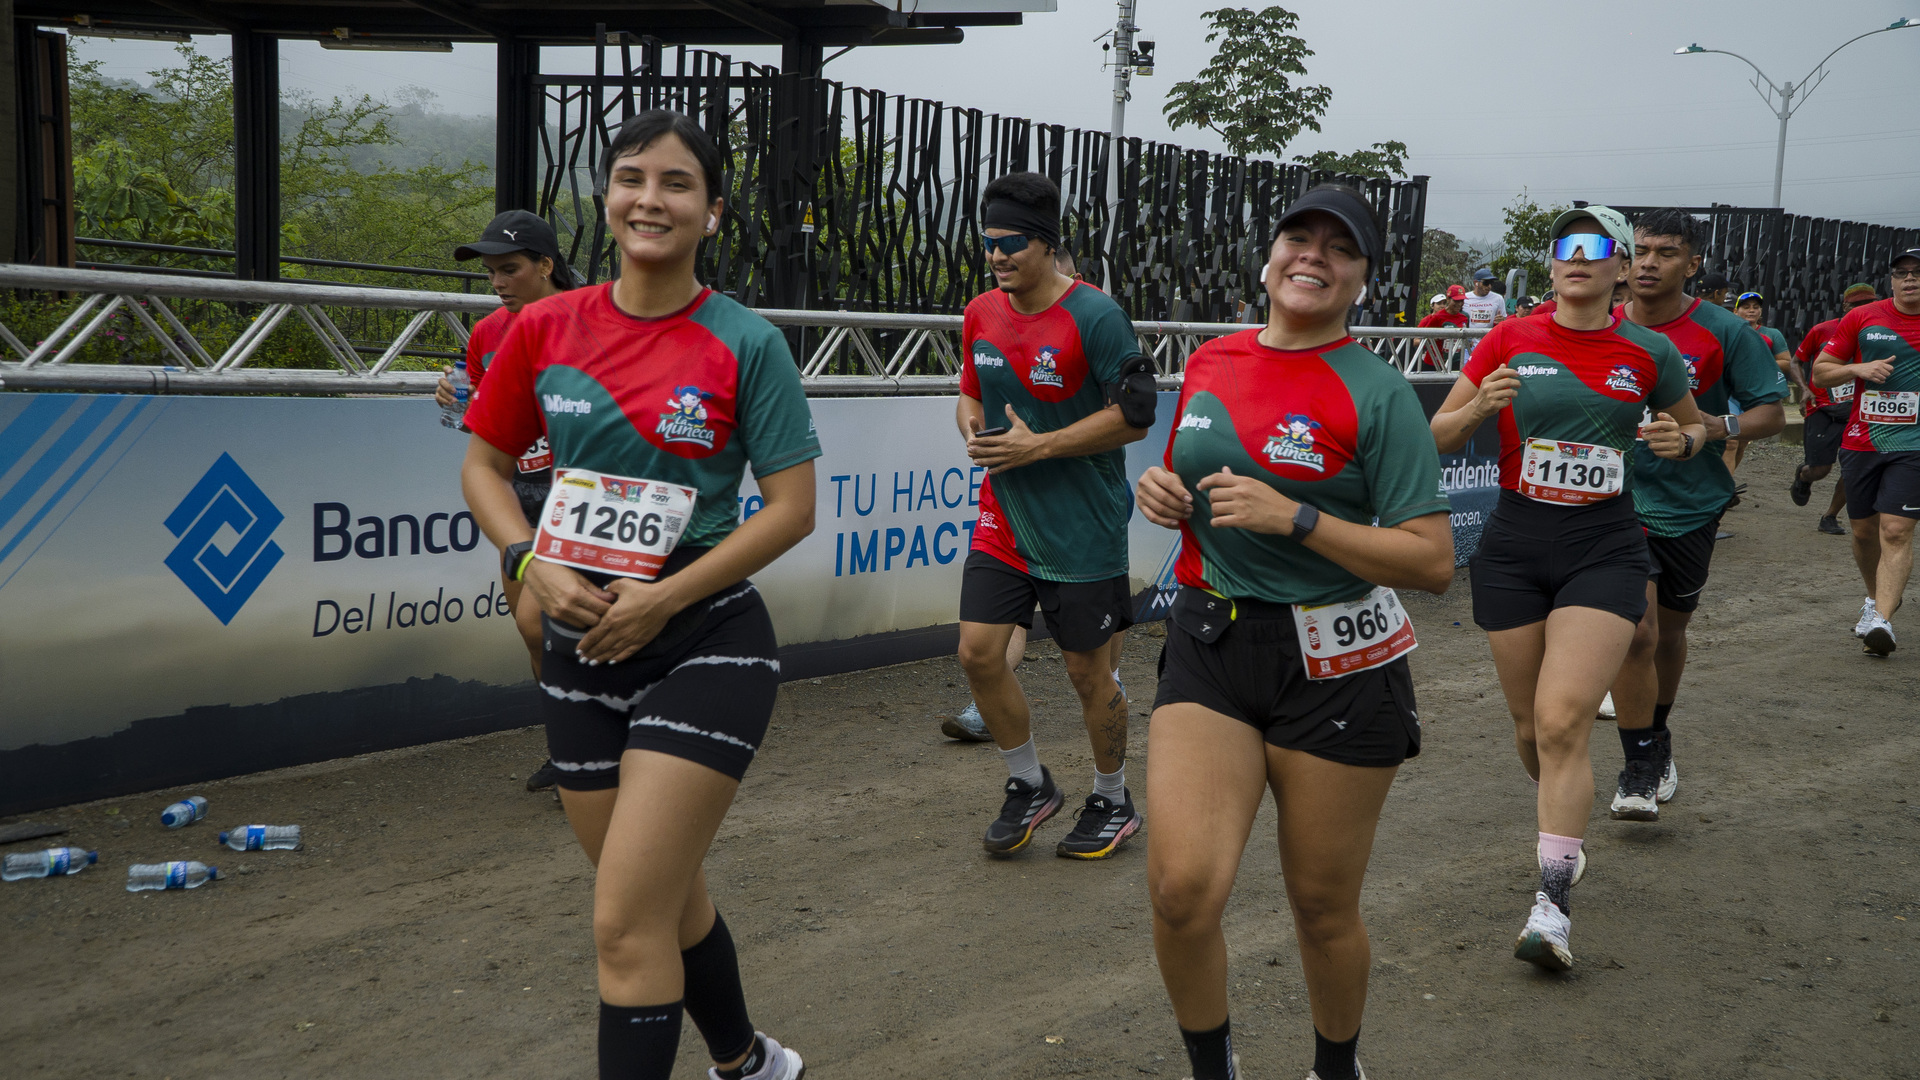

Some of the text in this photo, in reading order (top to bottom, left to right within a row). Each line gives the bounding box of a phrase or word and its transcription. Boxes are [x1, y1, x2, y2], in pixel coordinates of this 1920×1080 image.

[1600, 212, 1621, 227] 2XU
[1029, 370, 1063, 383] Muñeca
[1869, 401, 1907, 414] 1696
[656, 419, 715, 441] Muñeca
[674, 415, 688, 425] La
[1262, 440, 1325, 465] Muñeca
[1281, 438, 1294, 449] La
[1441, 458, 1500, 490] cidente
[1538, 460, 1605, 488] 1130
[651, 494, 671, 503] eggy
[831, 473, 876, 518] TU
[552, 505, 565, 522] 10K
[570, 501, 663, 546] 1266
[313, 502, 480, 562] Banco
[312, 581, 511, 638] Del lado de
[1333, 602, 1388, 647] 966
[1308, 631, 1320, 646] 10K
